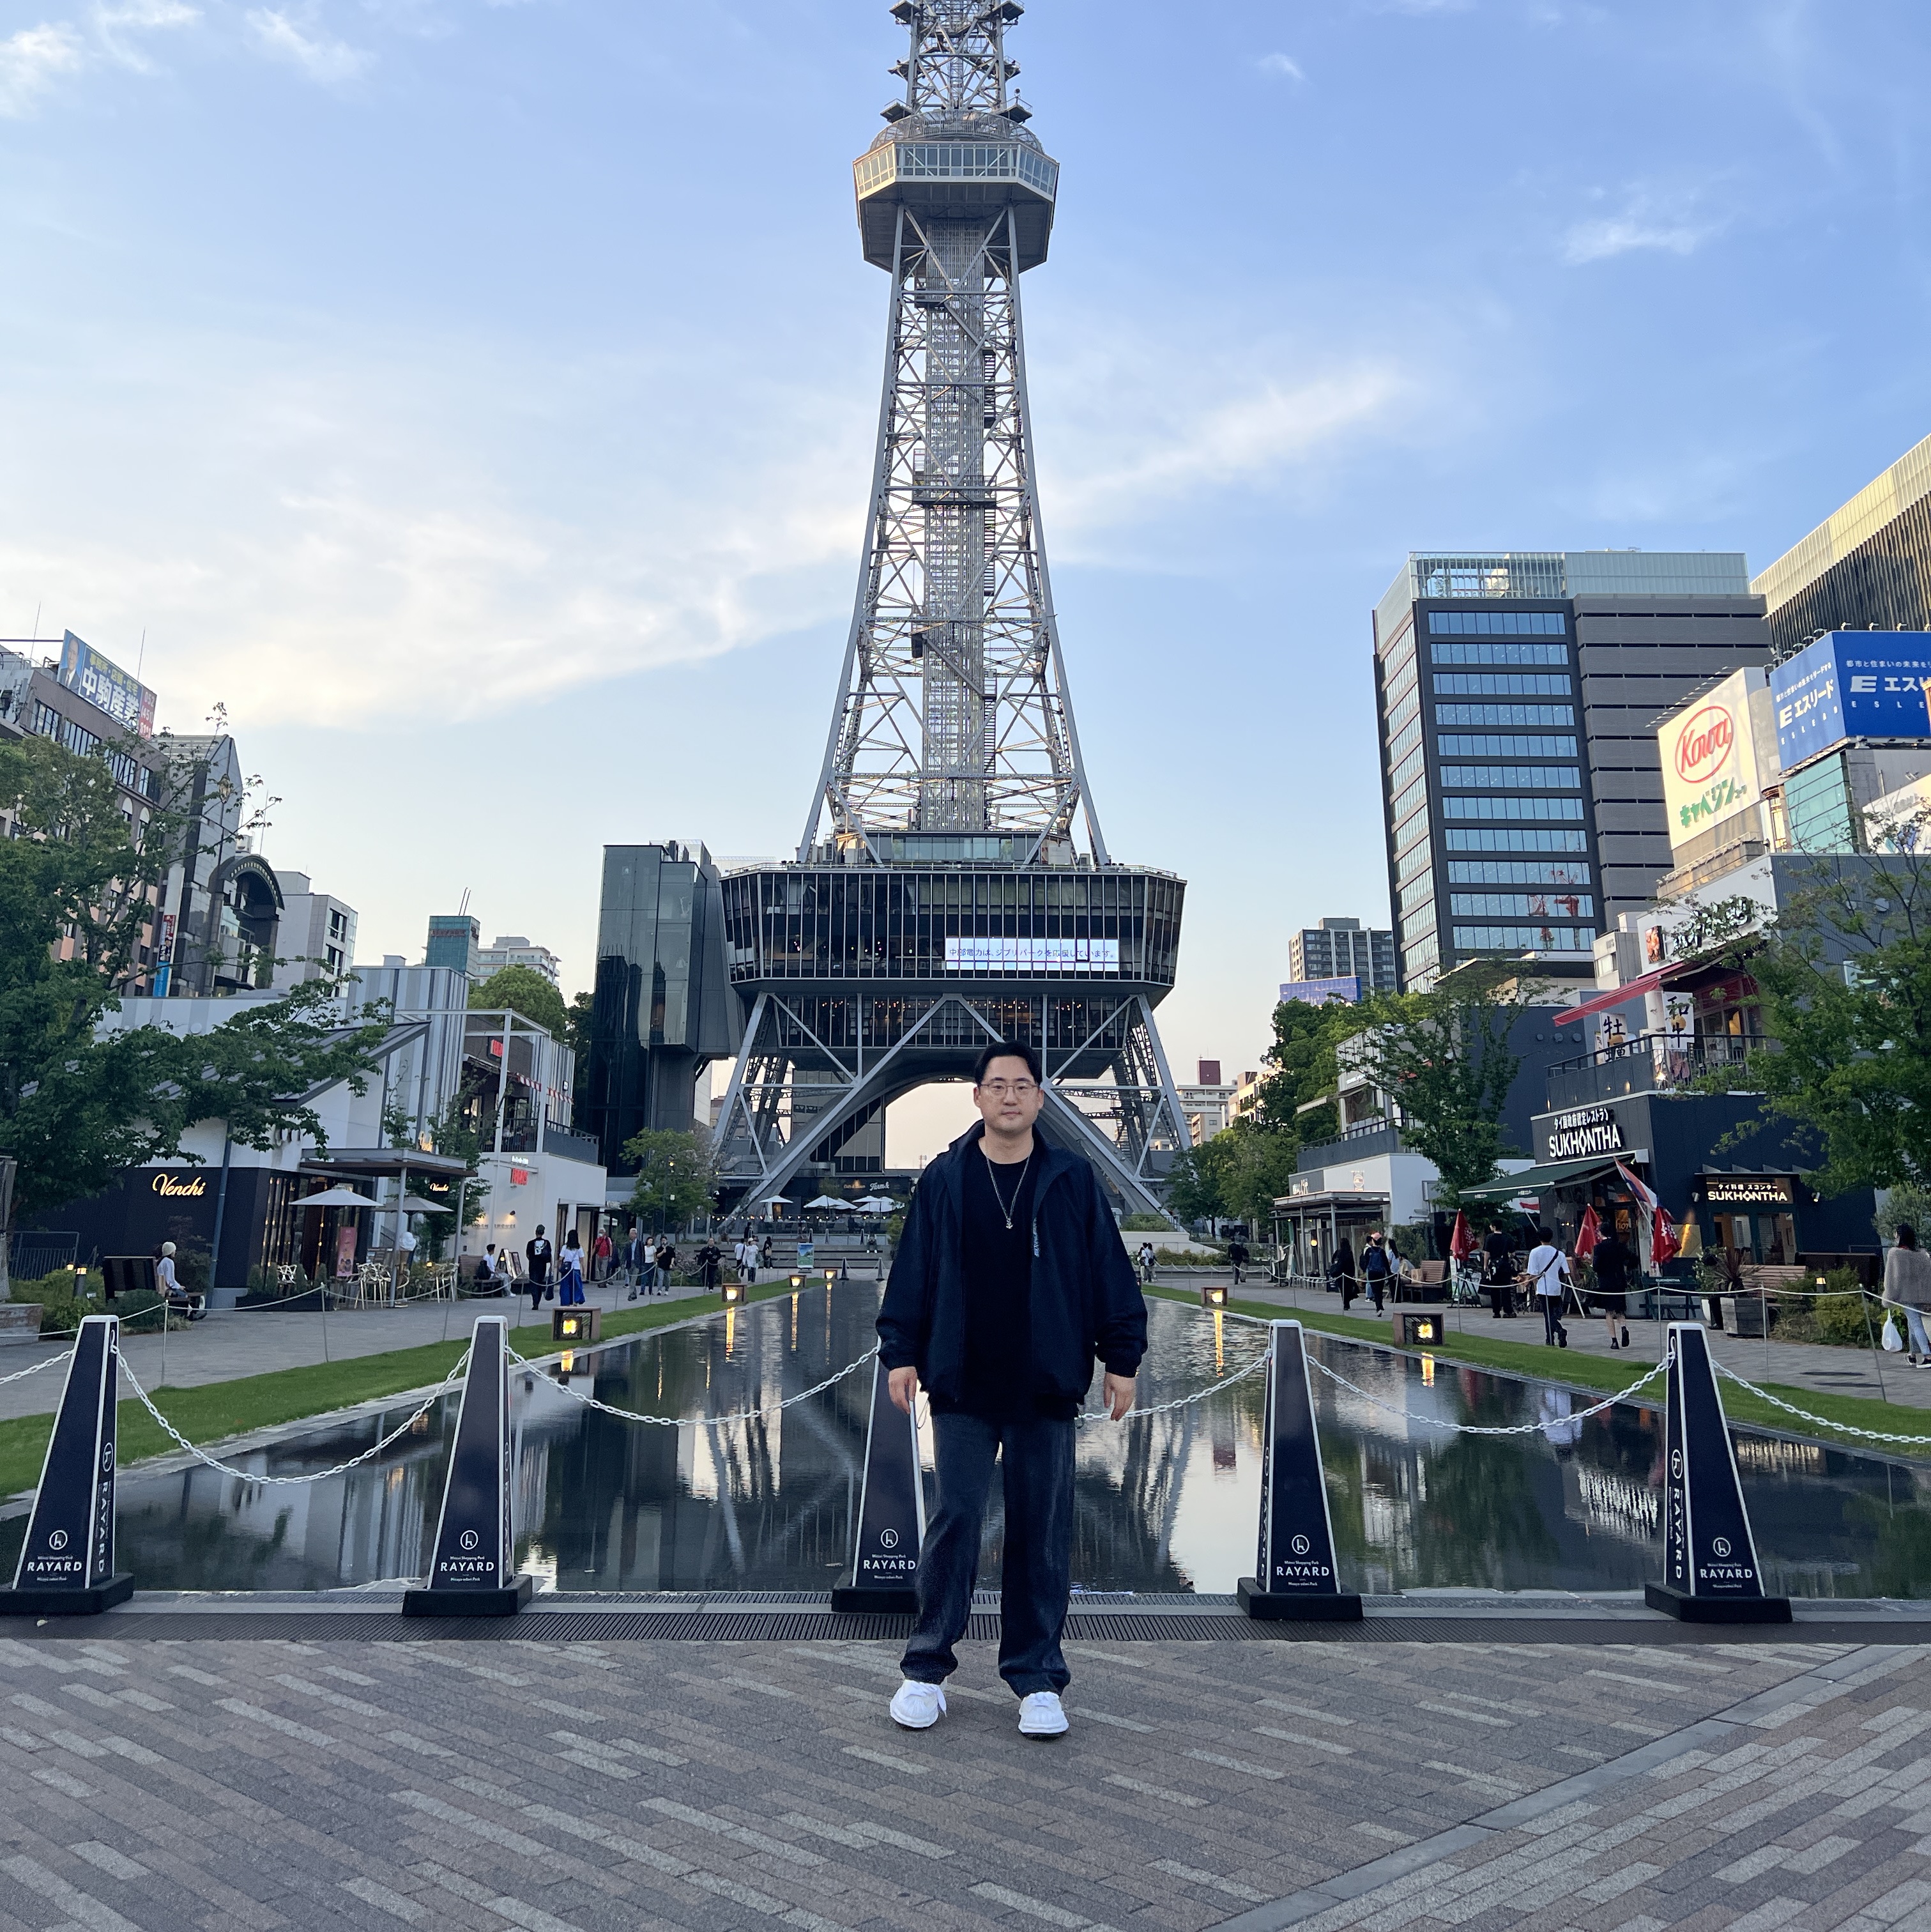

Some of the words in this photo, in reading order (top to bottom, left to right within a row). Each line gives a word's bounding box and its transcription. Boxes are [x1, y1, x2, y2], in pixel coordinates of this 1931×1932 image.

[82, 666, 140, 726] 中駒産業
[1794, 679, 1834, 717] エスリード
[1681, 717, 1732, 774] Kowa
[1680, 777, 1735, 828] キャベジン
[1548, 1124, 1622, 1158] SUKHONTHA
[152, 1173, 206, 1197] Venchi
[1707, 1190, 1788, 1202] SUKHONTHA
[98, 1481, 109, 1573] RAYARD
[1674, 1487, 1683, 1579] RAYARD
[27, 1561, 82, 1572] RAYARD
[440, 1561, 494, 1572] RAYARD
[863, 1560, 916, 1570] RAYARD
[1276, 1566, 1329, 1576] RAYARD
[1700, 1568, 1753, 1579] RAYARD
